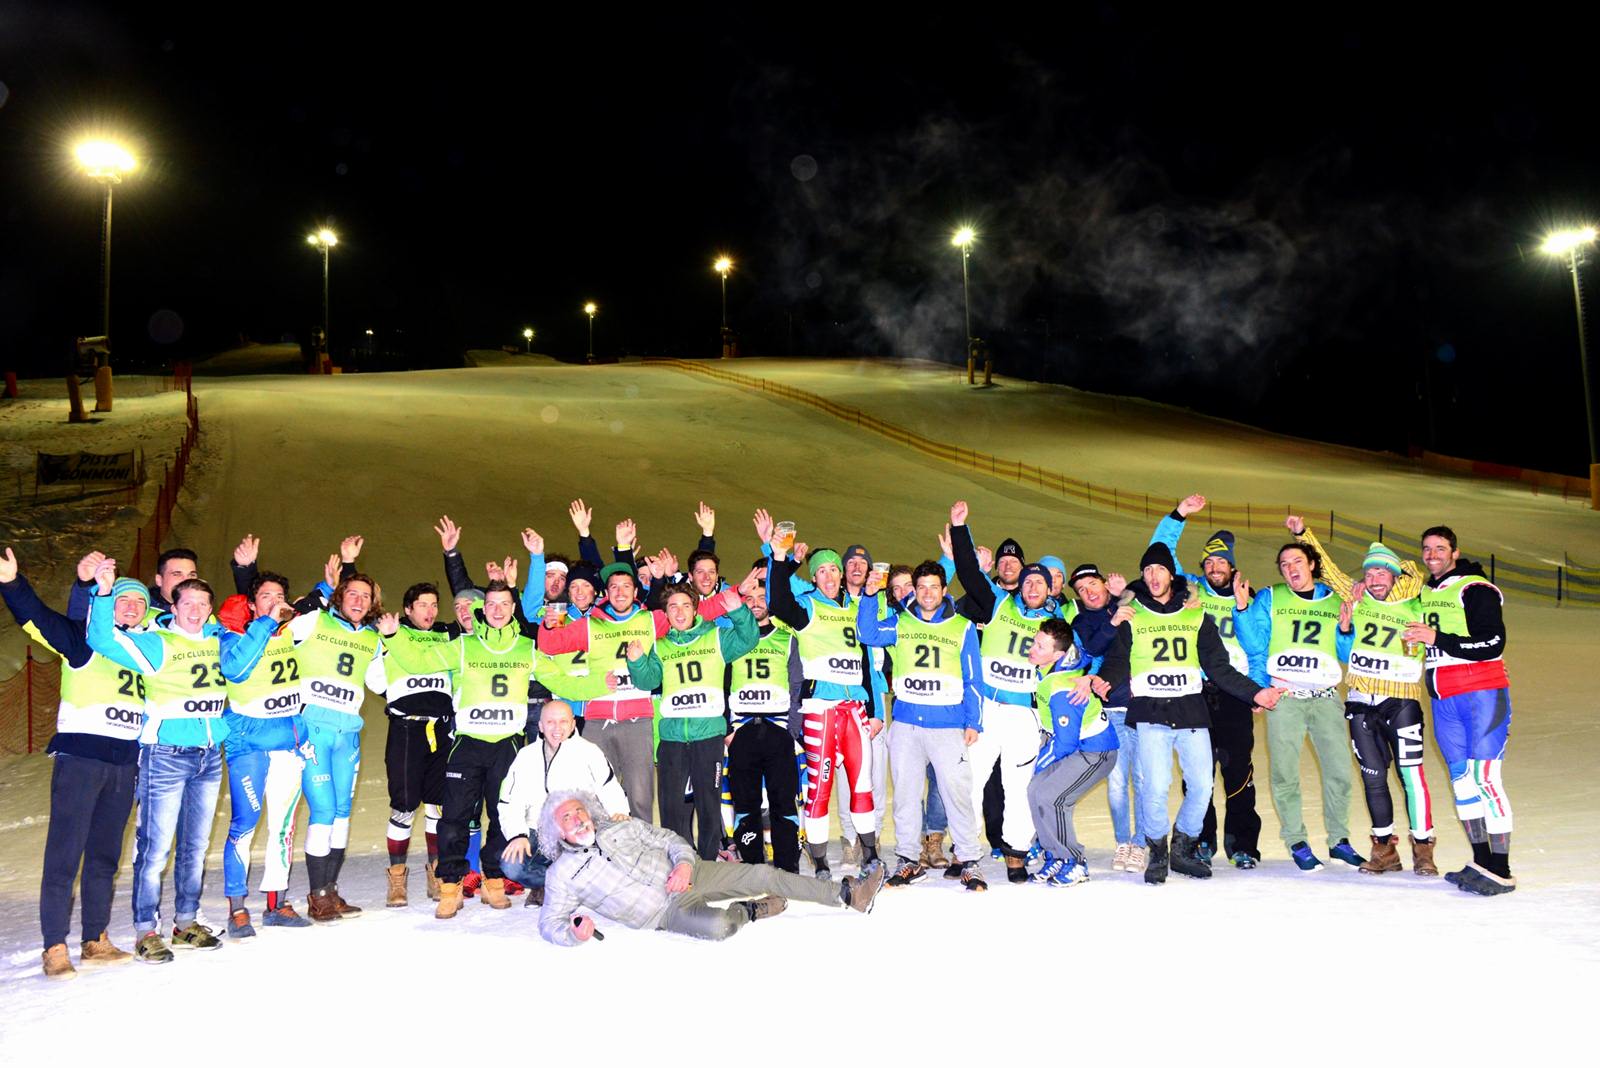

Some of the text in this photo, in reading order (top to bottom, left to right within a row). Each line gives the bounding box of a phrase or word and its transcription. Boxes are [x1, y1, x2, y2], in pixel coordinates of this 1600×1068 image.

[79, 454, 119, 467] PISTA
[1000, 614, 1009, 623] SCI
[1010, 618, 1026, 630] CLUB
[1366, 610, 1380, 619] CLUB
[1381, 613, 1410, 625] BOLBE
[604, 631, 621, 639] CLUB
[842, 626, 857, 648] 9
[1136, 624, 1198, 635] SCI CLUB BOLBENO
[1291, 619, 1322, 645] 12
[1361, 622, 1398, 648] 27
[316, 633, 329, 642] SCI
[329, 636, 348, 647] CLUB
[929, 634, 958, 647] BOLBENO
[172, 653, 185, 661] SCI
[187, 650, 207, 659] CLUB
[267, 648, 281, 657] CLUB
[615, 641, 629, 659] 4
[670, 650, 686, 660] CLUB
[687, 647, 716, 656] BOLBENO
[914, 644, 940, 668] 21
[1152, 636, 1187, 662] 20
[336, 652, 355, 676] 8
[745, 658, 770, 679] 15
[828, 657, 861, 670] oom
[1277, 655, 1319, 669] oom
[1351, 652, 1389, 670] oom
[191, 662, 226, 689] 23
[271, 657, 300, 685] 22
[675, 660, 702, 684] 10
[990, 661, 1031, 679] oom
[118, 669, 146, 702] 26
[407, 677, 445, 689] oom
[491, 673, 509, 697] 6
[904, 677, 941, 691] oom
[1147, 673, 1187, 687] oom
[310, 680, 355, 702] oom
[671, 692, 706, 706] oom
[739, 689, 771, 701] oom
[184, 699, 224, 712] oom
[264, 692, 300, 710] oom
[105, 706, 142, 725] oom
[469, 708, 514, 721] oom
[1397, 723, 1423, 766] ITA
